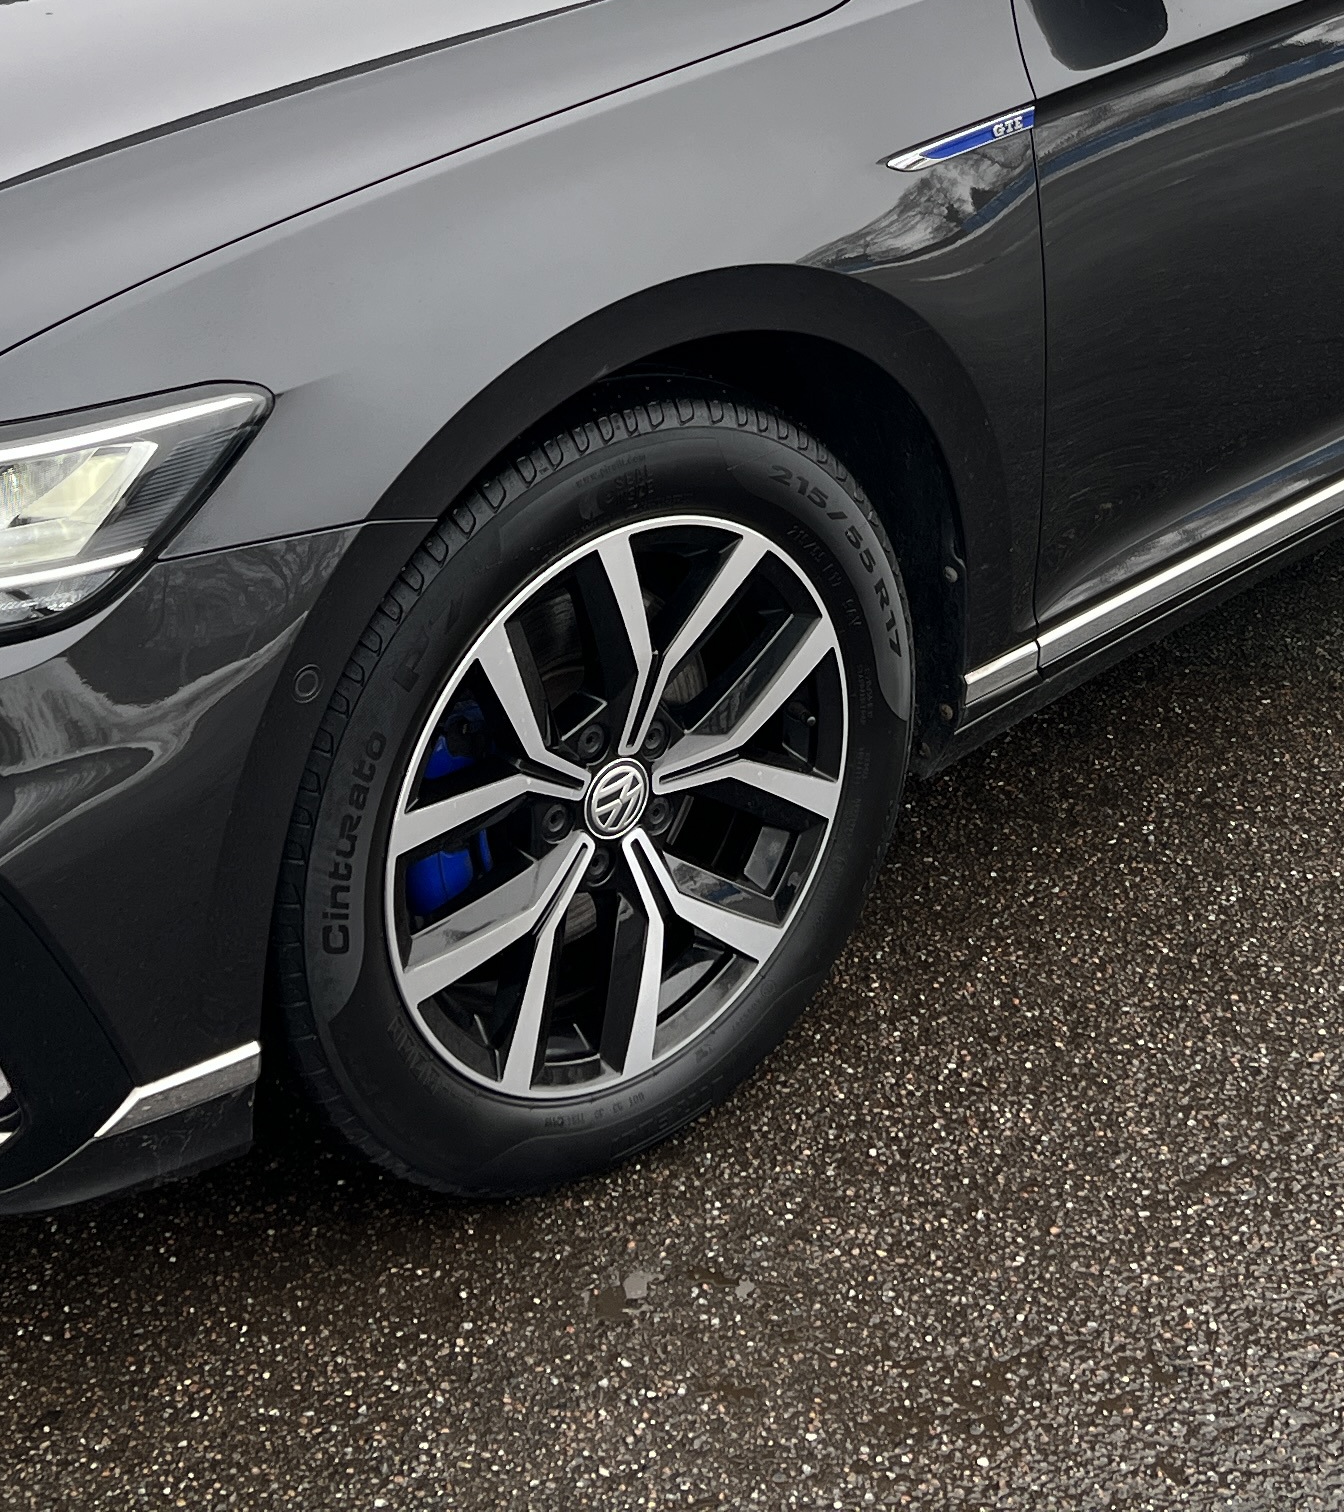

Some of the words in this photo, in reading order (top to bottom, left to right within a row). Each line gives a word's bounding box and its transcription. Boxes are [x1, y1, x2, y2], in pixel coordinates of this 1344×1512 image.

[992, 116, 1023, 138] GTE
[768, 464, 876, 574] 215/55
[874, 577, 902, 658] R17
